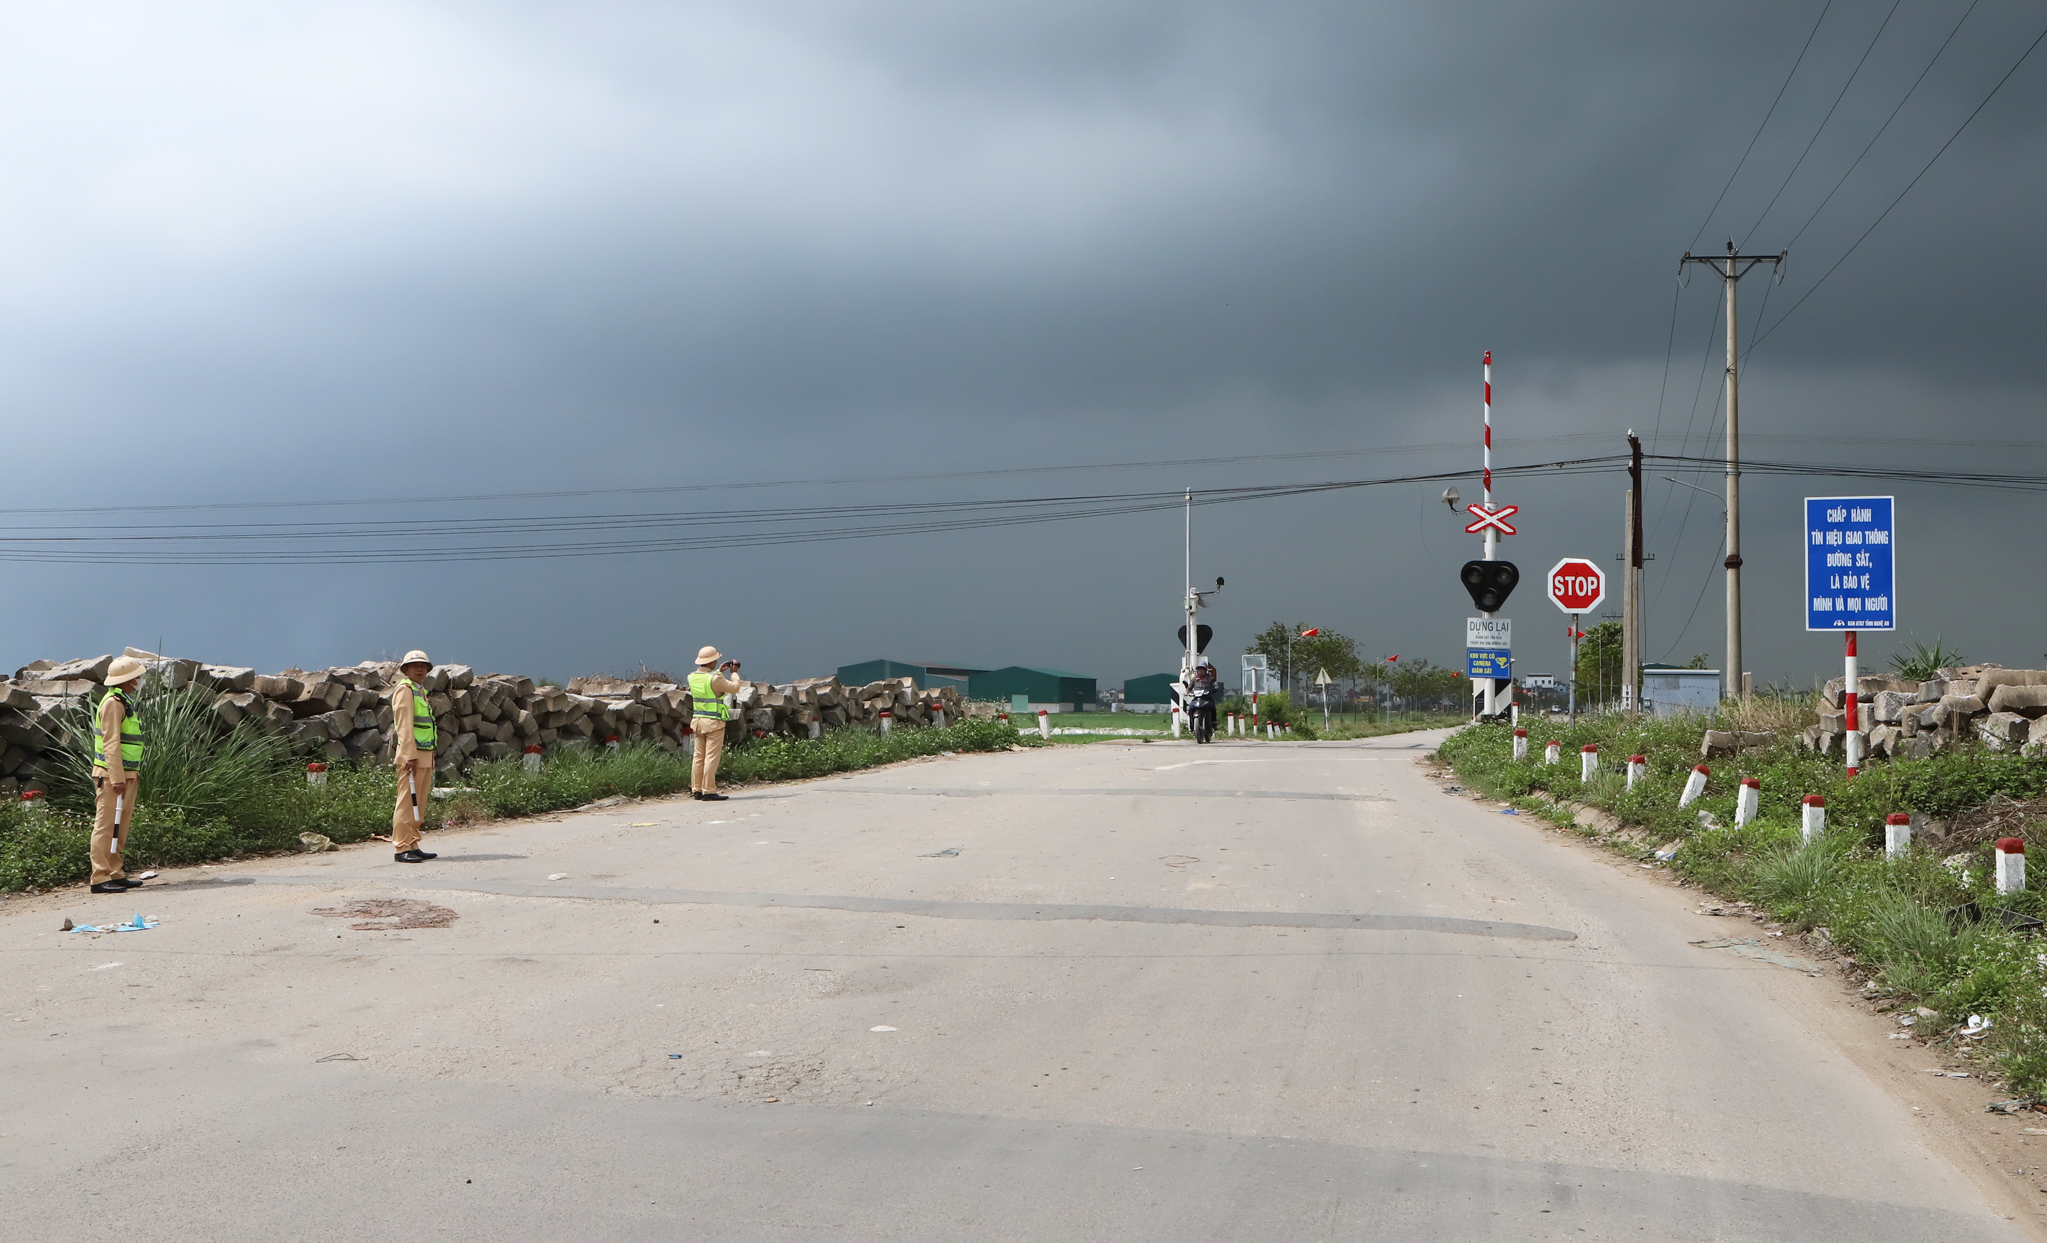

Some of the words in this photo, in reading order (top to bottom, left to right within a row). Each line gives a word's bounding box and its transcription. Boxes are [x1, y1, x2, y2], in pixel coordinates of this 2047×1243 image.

[1827, 505, 1846, 522] CHẤP
[1851, 506, 1872, 522] HÀNH
[1811, 529, 1824, 545] TÍN
[1826, 529, 1842, 546] HIỆU
[1846, 531, 1862, 544] GIAO
[1865, 528, 1888, 544] THÔNG
[1827, 550, 1852, 566] ĐƯỜNG
[1554, 576, 1598, 596] STOP
[1830, 574, 1840, 589] LÀ
[1843, 571, 1858, 589] BẢO
[1860, 572, 1870, 590] VỆ
[1814, 596, 1832, 611] MÌNH
[1836, 596, 1844, 611] VÀ
[1848, 598, 1861, 613] MỌI
[1865, 594, 1888, 611] NGƯỜI
